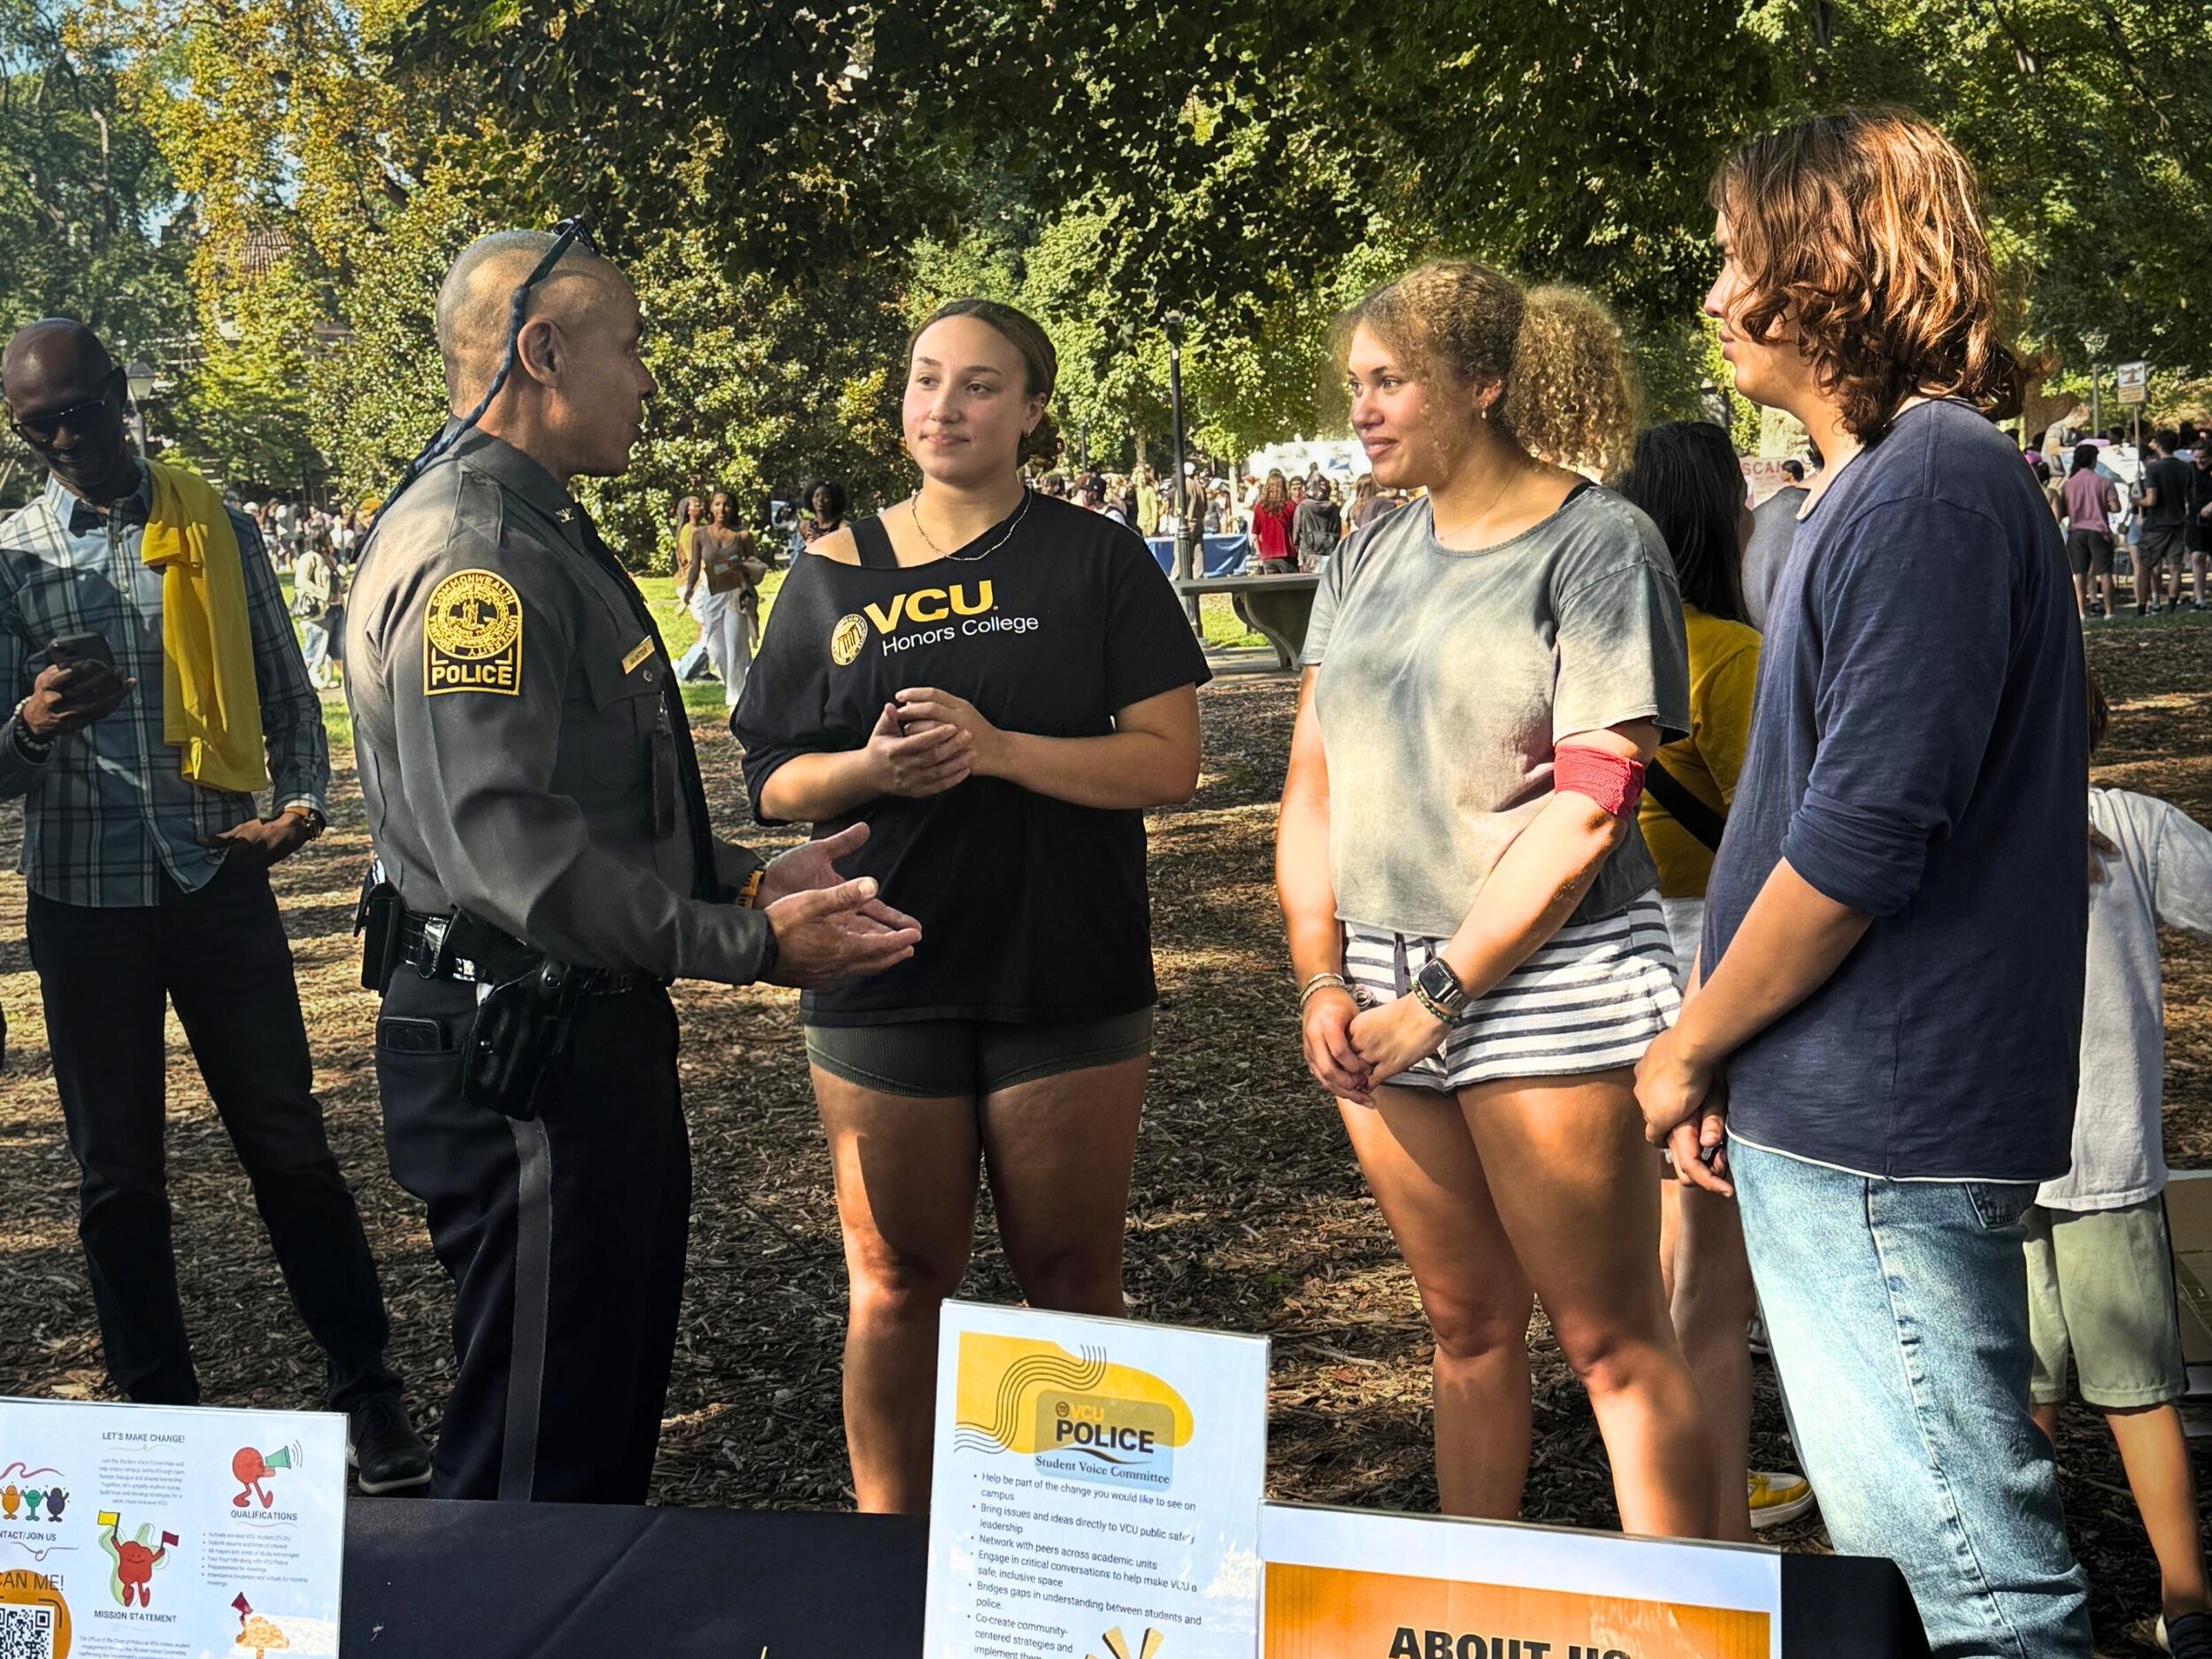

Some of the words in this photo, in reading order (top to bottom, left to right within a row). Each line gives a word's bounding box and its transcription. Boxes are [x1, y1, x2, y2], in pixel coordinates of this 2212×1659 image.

[433, 574, 513, 607] COMMONWEALTH
[864, 580, 994, 634] VCU
[467, 614, 518, 657] UNIVERSITY
[882, 624, 955, 657] Honors
[962, 616, 1039, 636] College
[432, 664, 512, 686] POLICE
[1069, 1402, 1104, 1421] VCU
[102, 1432, 124, 1440] LET'S
[126, 1432, 147, 1442] MAKE
[150, 1433, 185, 1443] CHANGE!
[1056, 1419, 1155, 1454] POLICE
[1036, 1455, 1076, 1471] Student
[1079, 1461, 1108, 1476] Voice
[1110, 1465, 1170, 1484] Committee
[981, 1488, 1015, 1502] campus
[982, 1472, 1001, 1484] Help
[1003, 1475, 1013, 1486] be
[1015, 1479, 1033, 1487] part
[1034, 1479, 1043, 1489] of
[1045, 1481, 1058, 1492] the
[1061, 1483, 1091, 1497] change
[1094, 1490, 1110, 1500] you
[1111, 1492, 1137, 1503] would
[1140, 1494, 1154, 1505] like
[1156, 1497, 1164, 1507] to
[1167, 1500, 1182, 1509] see
[1185, 1502, 1196, 1511] on
[231, 1509, 297, 1521] QUALIFICATIONS
[979, 1518, 1024, 1535] leadership
[981, 1503, 1002, 1517] Bring
[1004, 1507, 1031, 1519] issues
[1033, 1512, 1048, 1522] and
[1051, 1514, 1073, 1525] ideas
[1076, 1517, 1107, 1532] directly
[1109, 1523, 1118, 1532] to
[1119, 1523, 1139, 1534] VCU
[1140, 1527, 1166, 1539] public
[46, 1532, 57, 1541] US
[979, 1534, 1014, 1548] Network
[1016, 1540, 1033, 1551] with
[1035, 1544, 1059, 1555] peers
[1061, 1548, 1089, 1560] across
[1092, 1553, 1134, 1566] academic
[1136, 1559, 1157, 1570] units
[34, 1574, 64, 1592] ME!
[978, 1566, 997, 1578] safe,
[999, 1570, 1036, 1583] inclusive
[1038, 1576, 1063, 1587] space
[979, 1549, 1010, 1564] Engage
[1011, 1555, 1019, 1564] in
[1021, 1557, 1048, 1569] critical
[1050, 1562, 1110, 1579] conversations
[1113, 1571, 1121, 1580] to
[1124, 1572, 1142, 1585] help
[1144, 1576, 1168, 1587] make
[1171, 1580, 1189, 1591] VCU
[977, 1581, 1008, 1595] Bridges
[1010, 1587, 1031, 1599] gaps
[1033, 1589, 1041, 1599] in
[1042, 1594, 1103, 1612] understanding
[1106, 1601, 1142, 1617] between
[1144, 1609, 1182, 1623] students
[1185, 1616, 1202, 1625] and
[94, 1610, 127, 1620] MISSION
[129, 1612, 177, 1624] STATEMENT
[976, 1612, 1016, 1628] Co-create
[1018, 1620, 1067, 1638] community-
[974, 1645, 1018, 1659] implement
[975, 1630, 1011, 1643] centered
[1013, 1636, 1055, 1651] strategies
[1056, 1643, 1073, 1653] and
[1388, 1627, 1551, 1659] ABOUT
